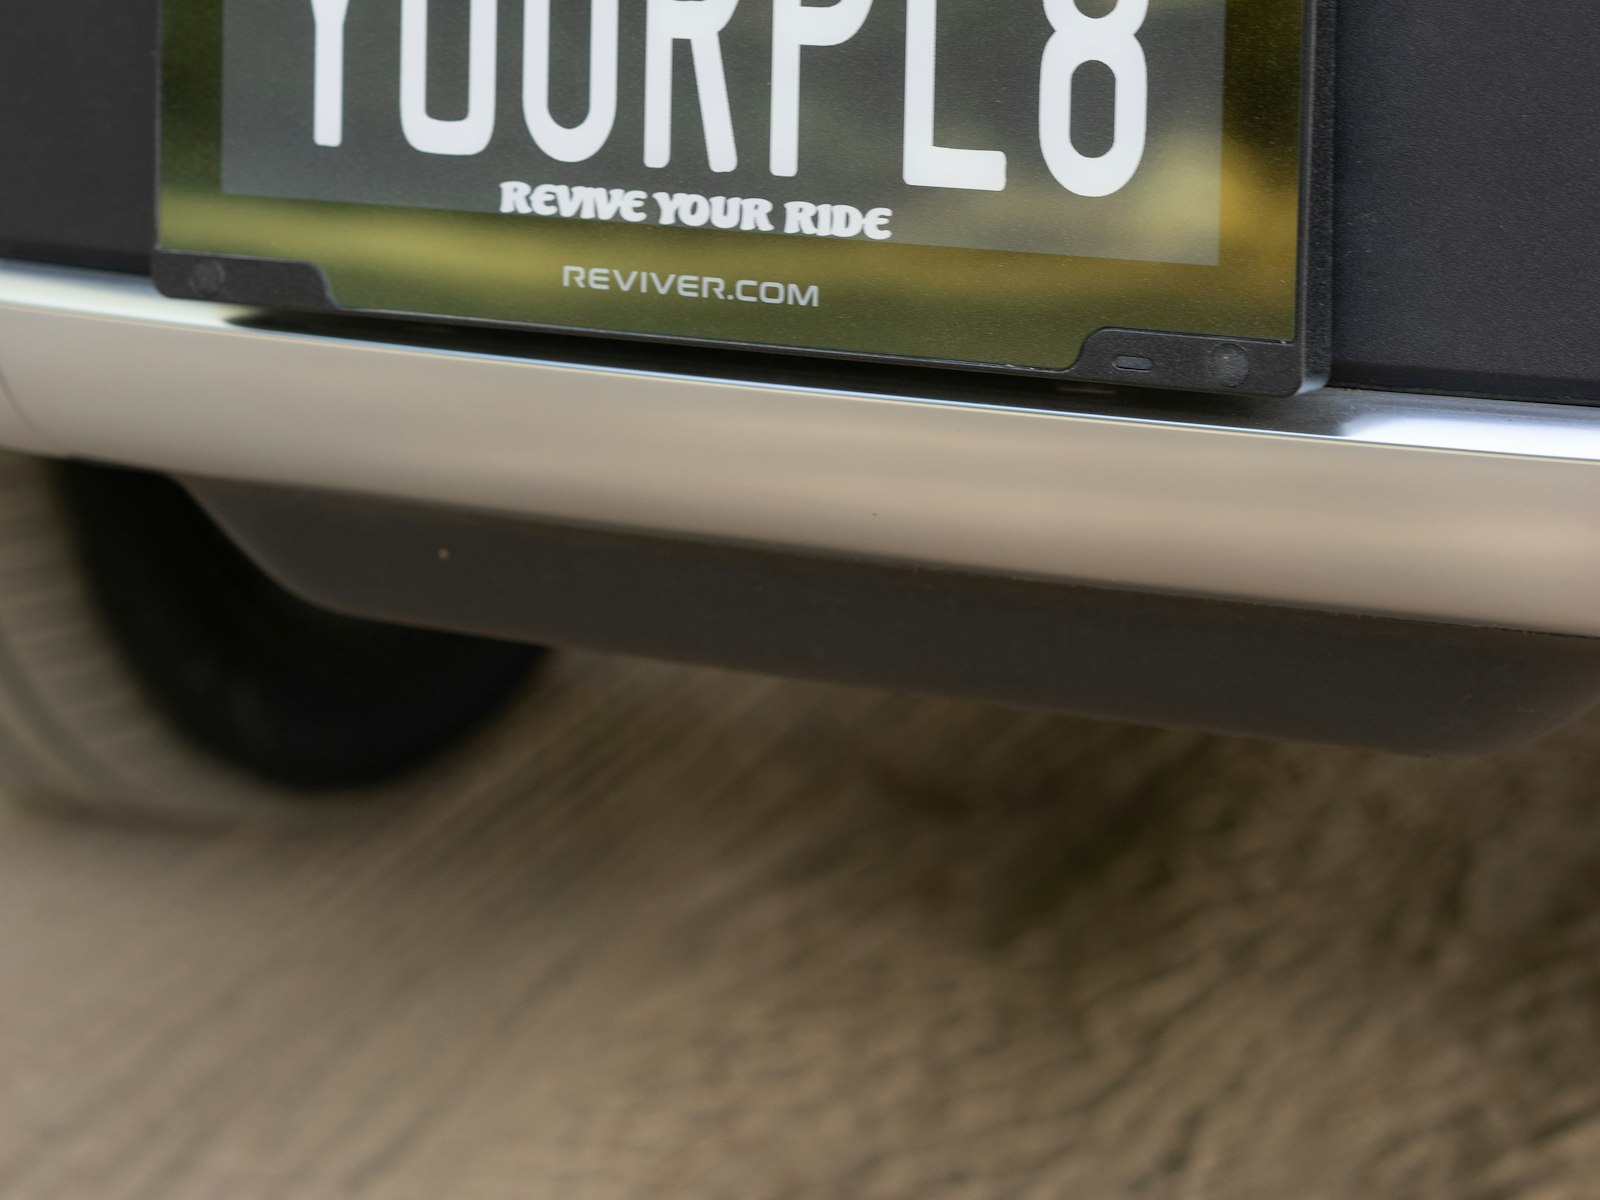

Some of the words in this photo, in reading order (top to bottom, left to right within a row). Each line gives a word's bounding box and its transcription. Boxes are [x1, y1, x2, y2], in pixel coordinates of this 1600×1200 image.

[499, 180, 648, 223] REVIVE
[651, 191, 775, 232] YOUR
[783, 200, 894, 241] RIDE
[561, 264, 820, 308] REVIVER.COM
